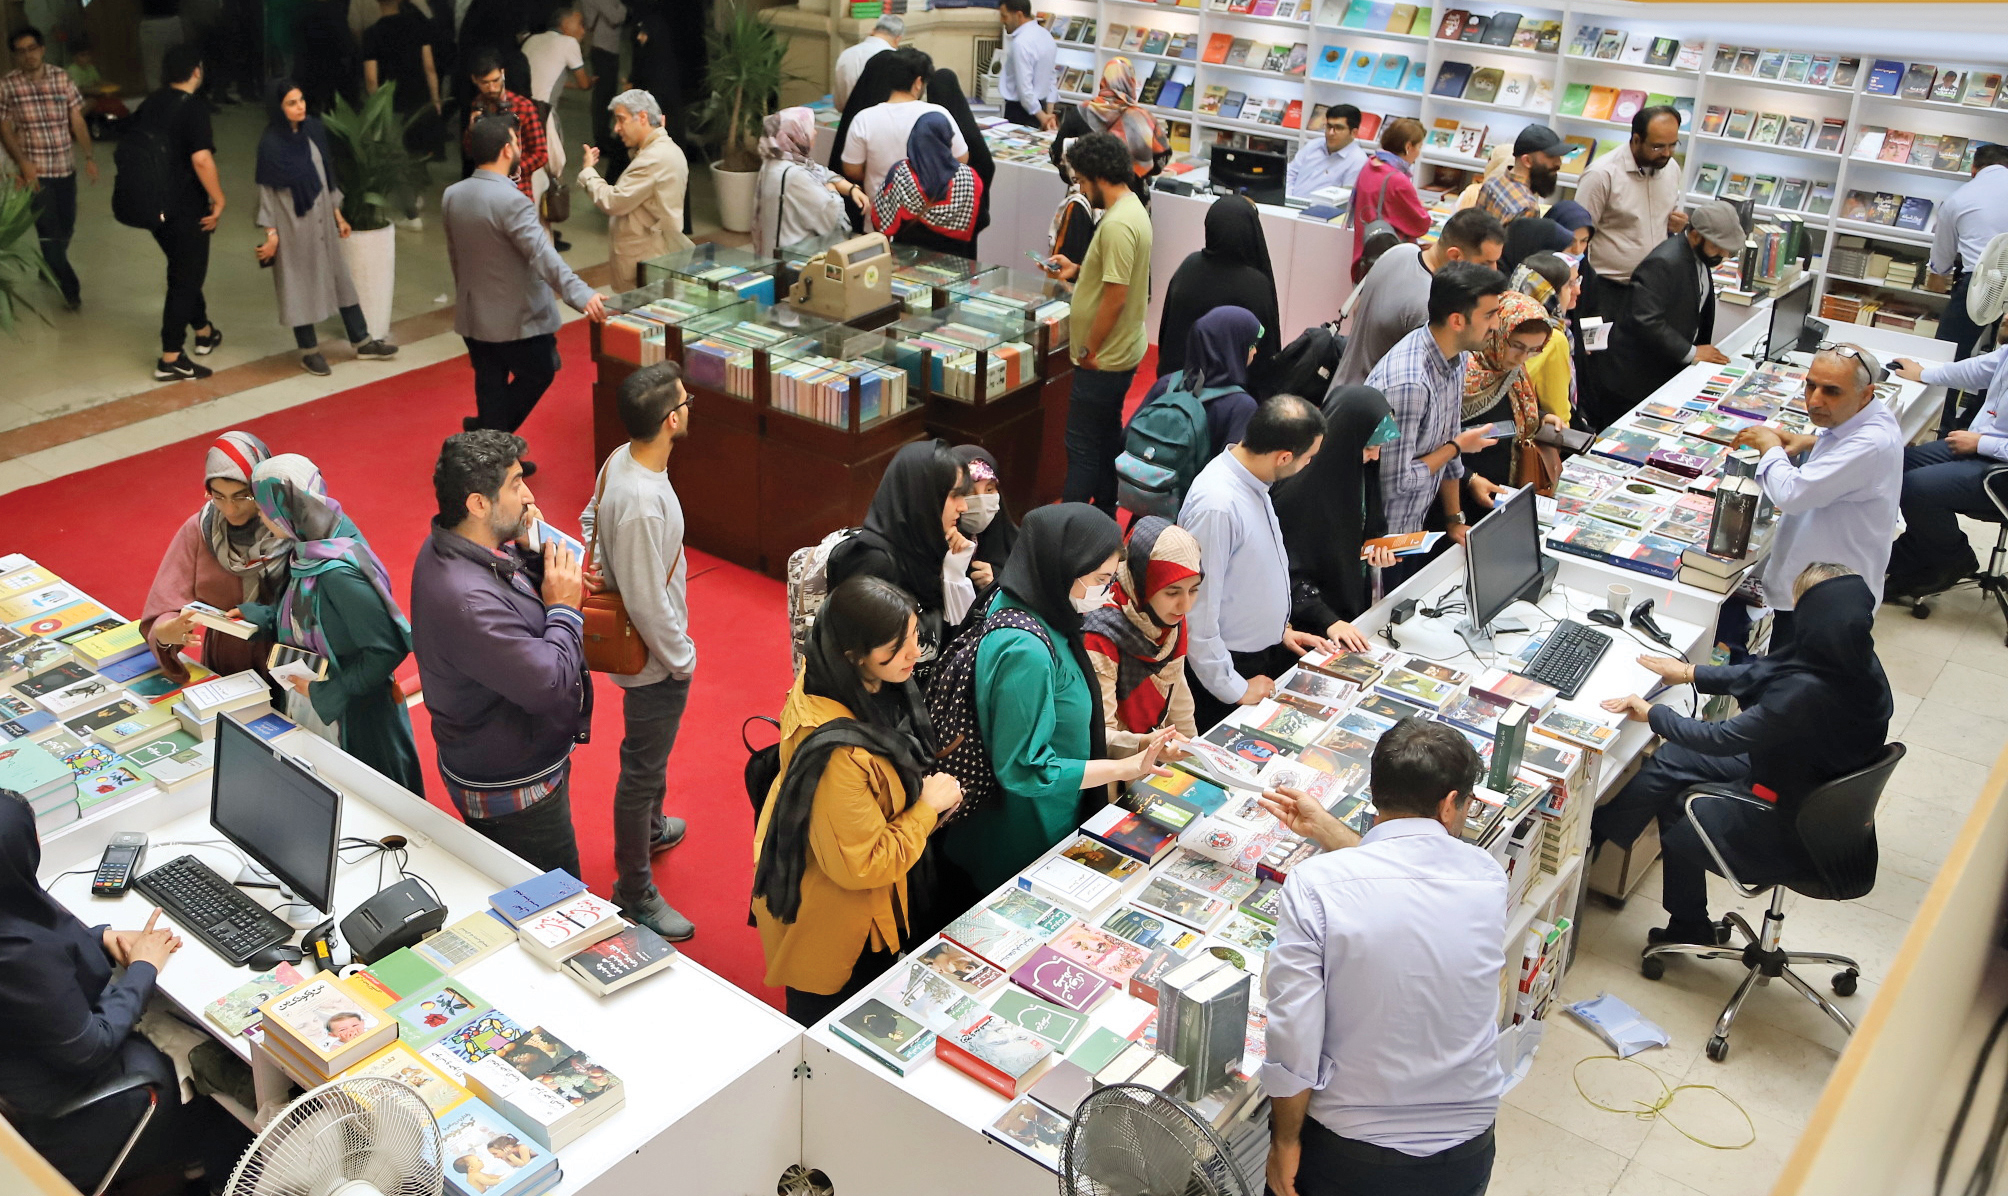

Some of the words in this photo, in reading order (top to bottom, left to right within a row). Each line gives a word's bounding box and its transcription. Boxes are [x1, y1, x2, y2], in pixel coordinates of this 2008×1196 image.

[312, 984, 325, 996] من
[289, 990, 309, 1007] کودک
[278, 1000, 291, 1011] من
